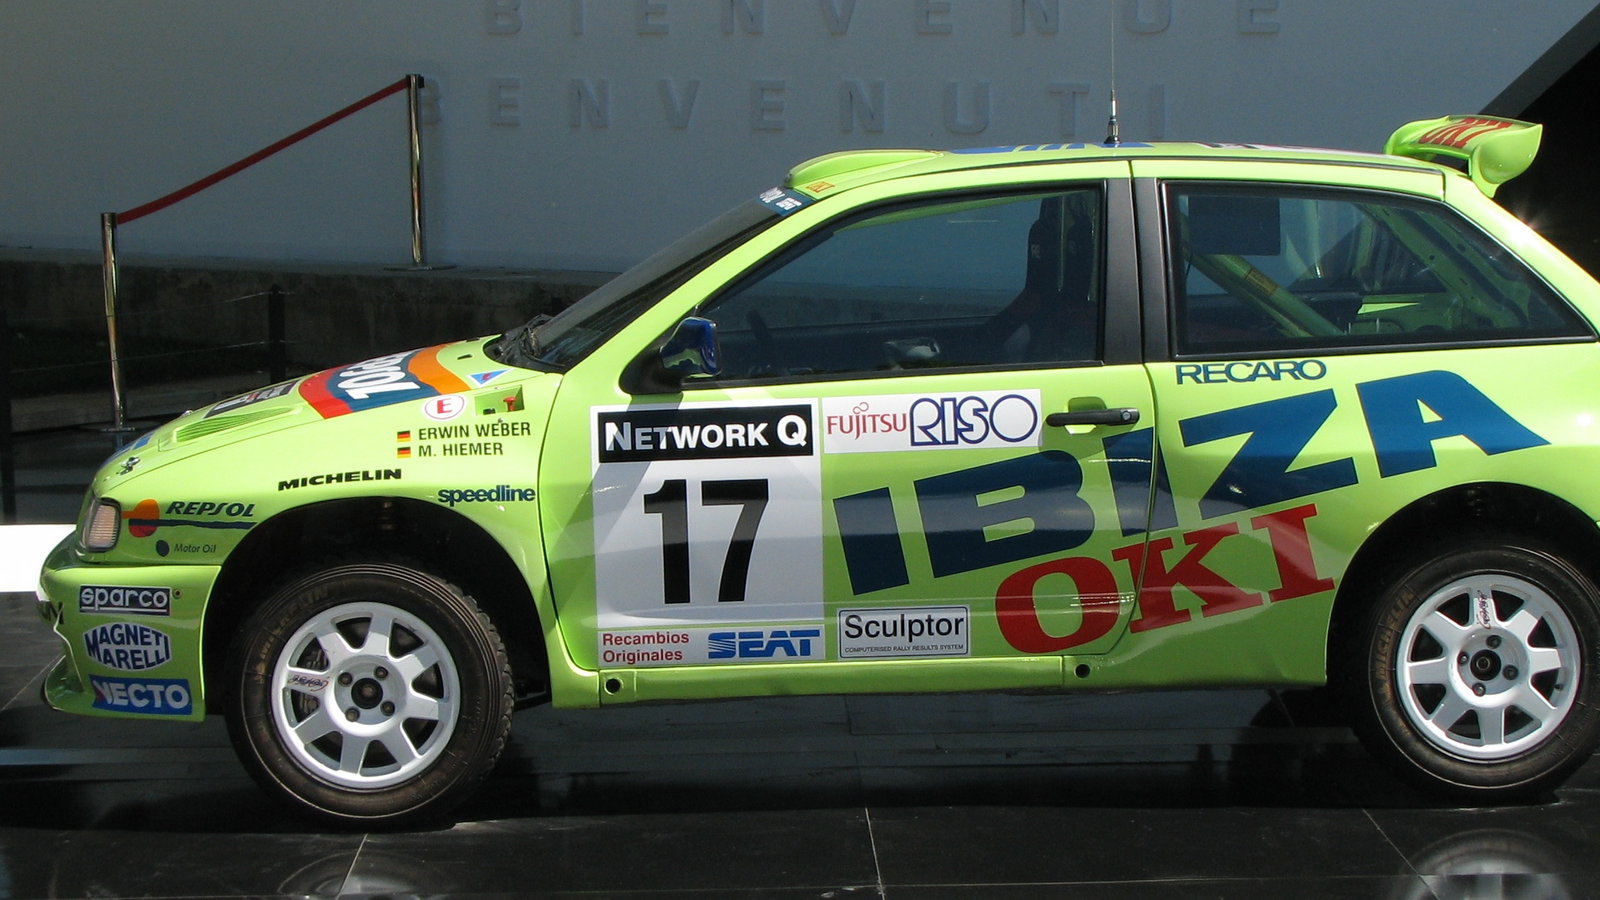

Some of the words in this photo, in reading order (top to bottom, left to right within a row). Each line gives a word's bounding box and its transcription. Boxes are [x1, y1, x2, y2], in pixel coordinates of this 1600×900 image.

[1176, 359, 1327, 385] RECARO
[437, 398, 453, 414] E
[418, 425, 470, 441] ERWIN
[475, 421, 532, 437] WEBER
[826, 402, 908, 440] FUJITSU
[909, 394, 1039, 446] RISO
[605, 421, 769, 451] NETWORK
[776, 414, 808, 447] Q
[418, 444, 437, 457] M.
[442, 442, 504, 456] HIEMER
[278, 468, 402, 491] MICHELIN
[833, 370, 1552, 596] IBIZA
[437, 485, 536, 507] speedline
[165, 501, 256, 517] REPSOL
[173, 543, 200, 553] Motor
[202, 543, 217, 553] Oil
[643, 478, 769, 604] 17
[994, 503, 1336, 654] OKI
[81, 587, 168, 611] sparco
[84, 623, 170, 650] MAGNETI
[602, 631, 690, 646] Recambios
[844, 614, 965, 643] Sculptor
[708, 629, 820, 659] SEAT
[844, 645, 892, 653] COMPUTERISED
[84, 646, 170, 670] MARELLI
[602, 649, 683, 665] Originales
